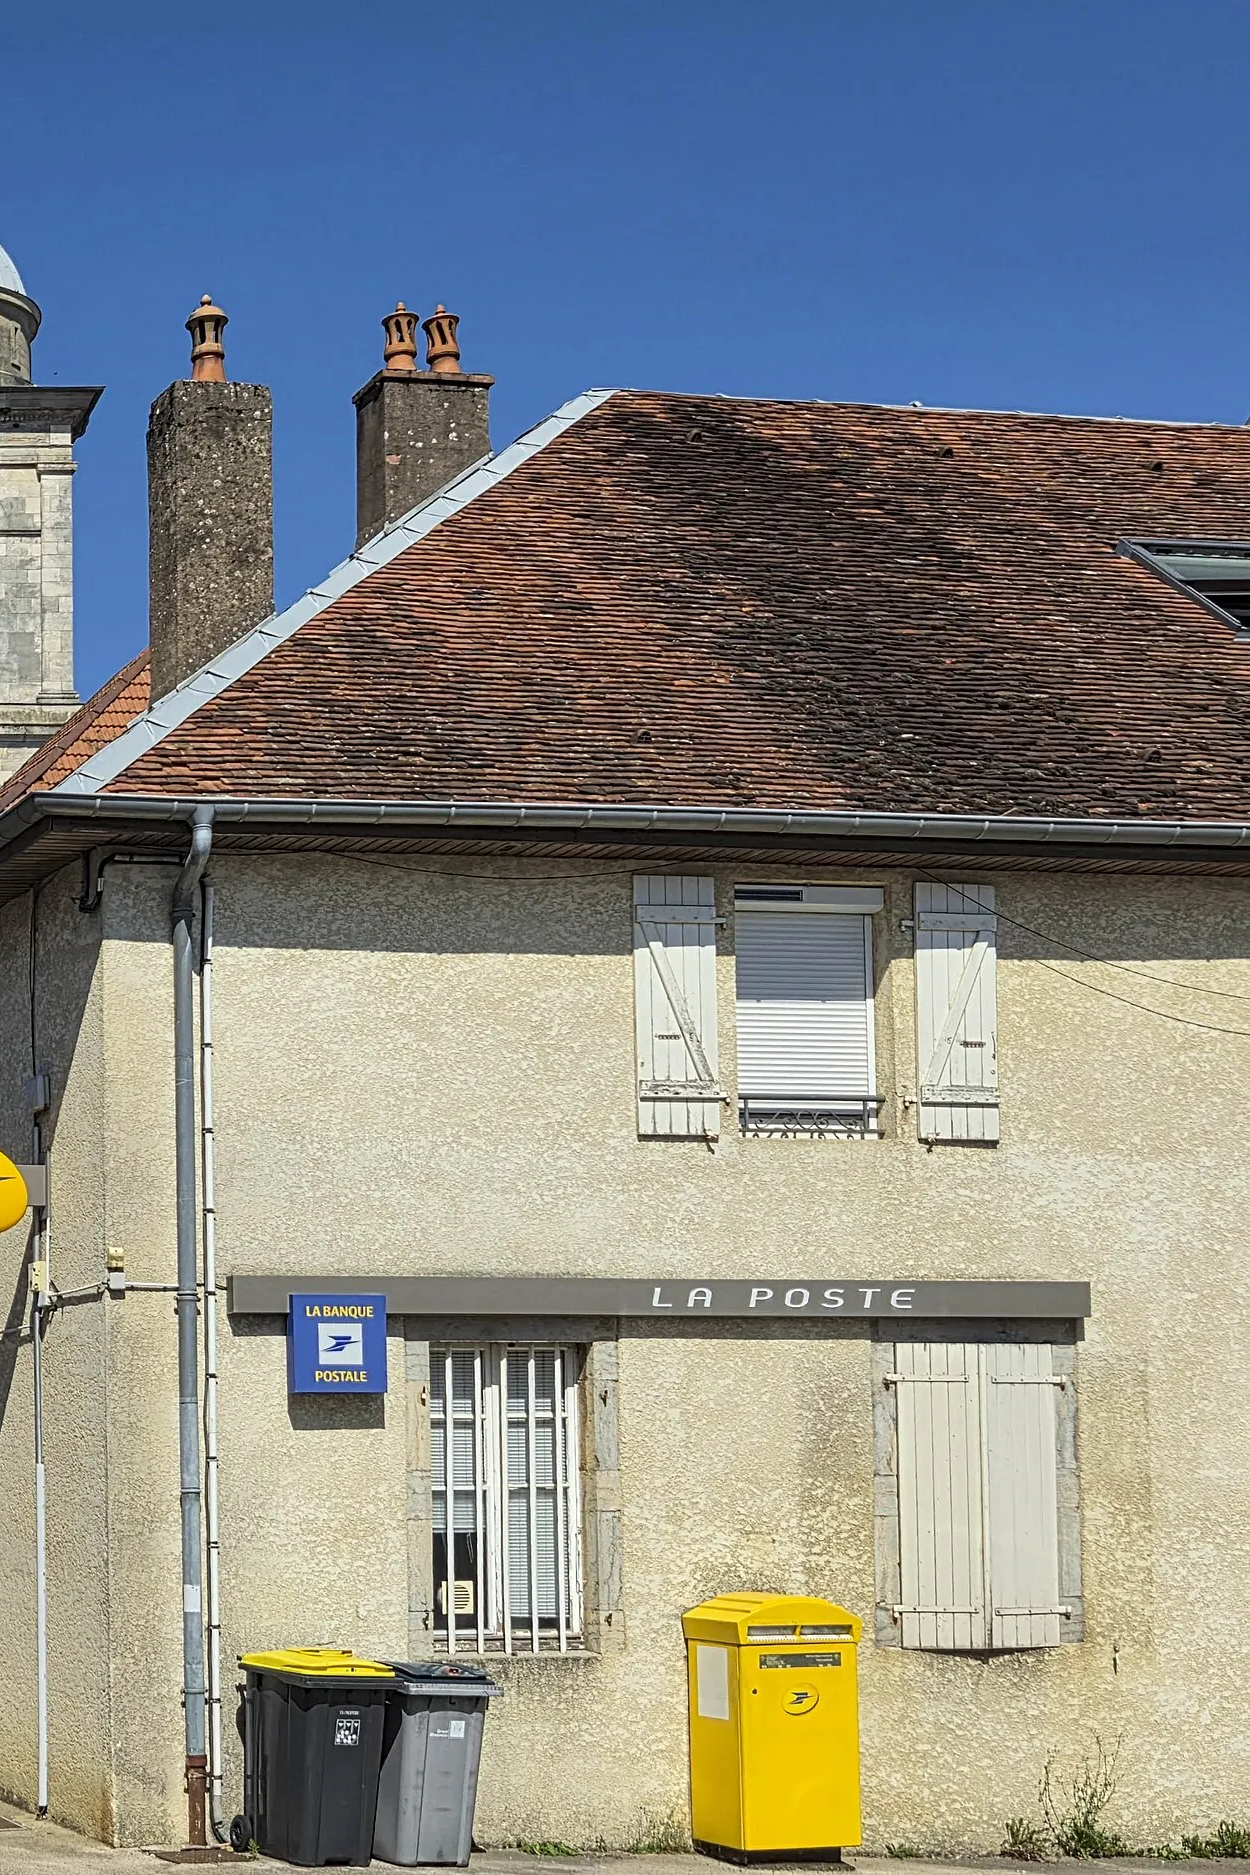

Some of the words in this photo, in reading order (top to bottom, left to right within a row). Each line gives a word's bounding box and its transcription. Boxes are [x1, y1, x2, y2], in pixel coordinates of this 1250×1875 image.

[652, 1287, 713, 1308] LA
[748, 1288, 916, 1309] POSTE
[306, 1305, 321, 1317] LA
[323, 1305, 374, 1319] BANQUE
[315, 1370, 368, 1382] POSTALE
